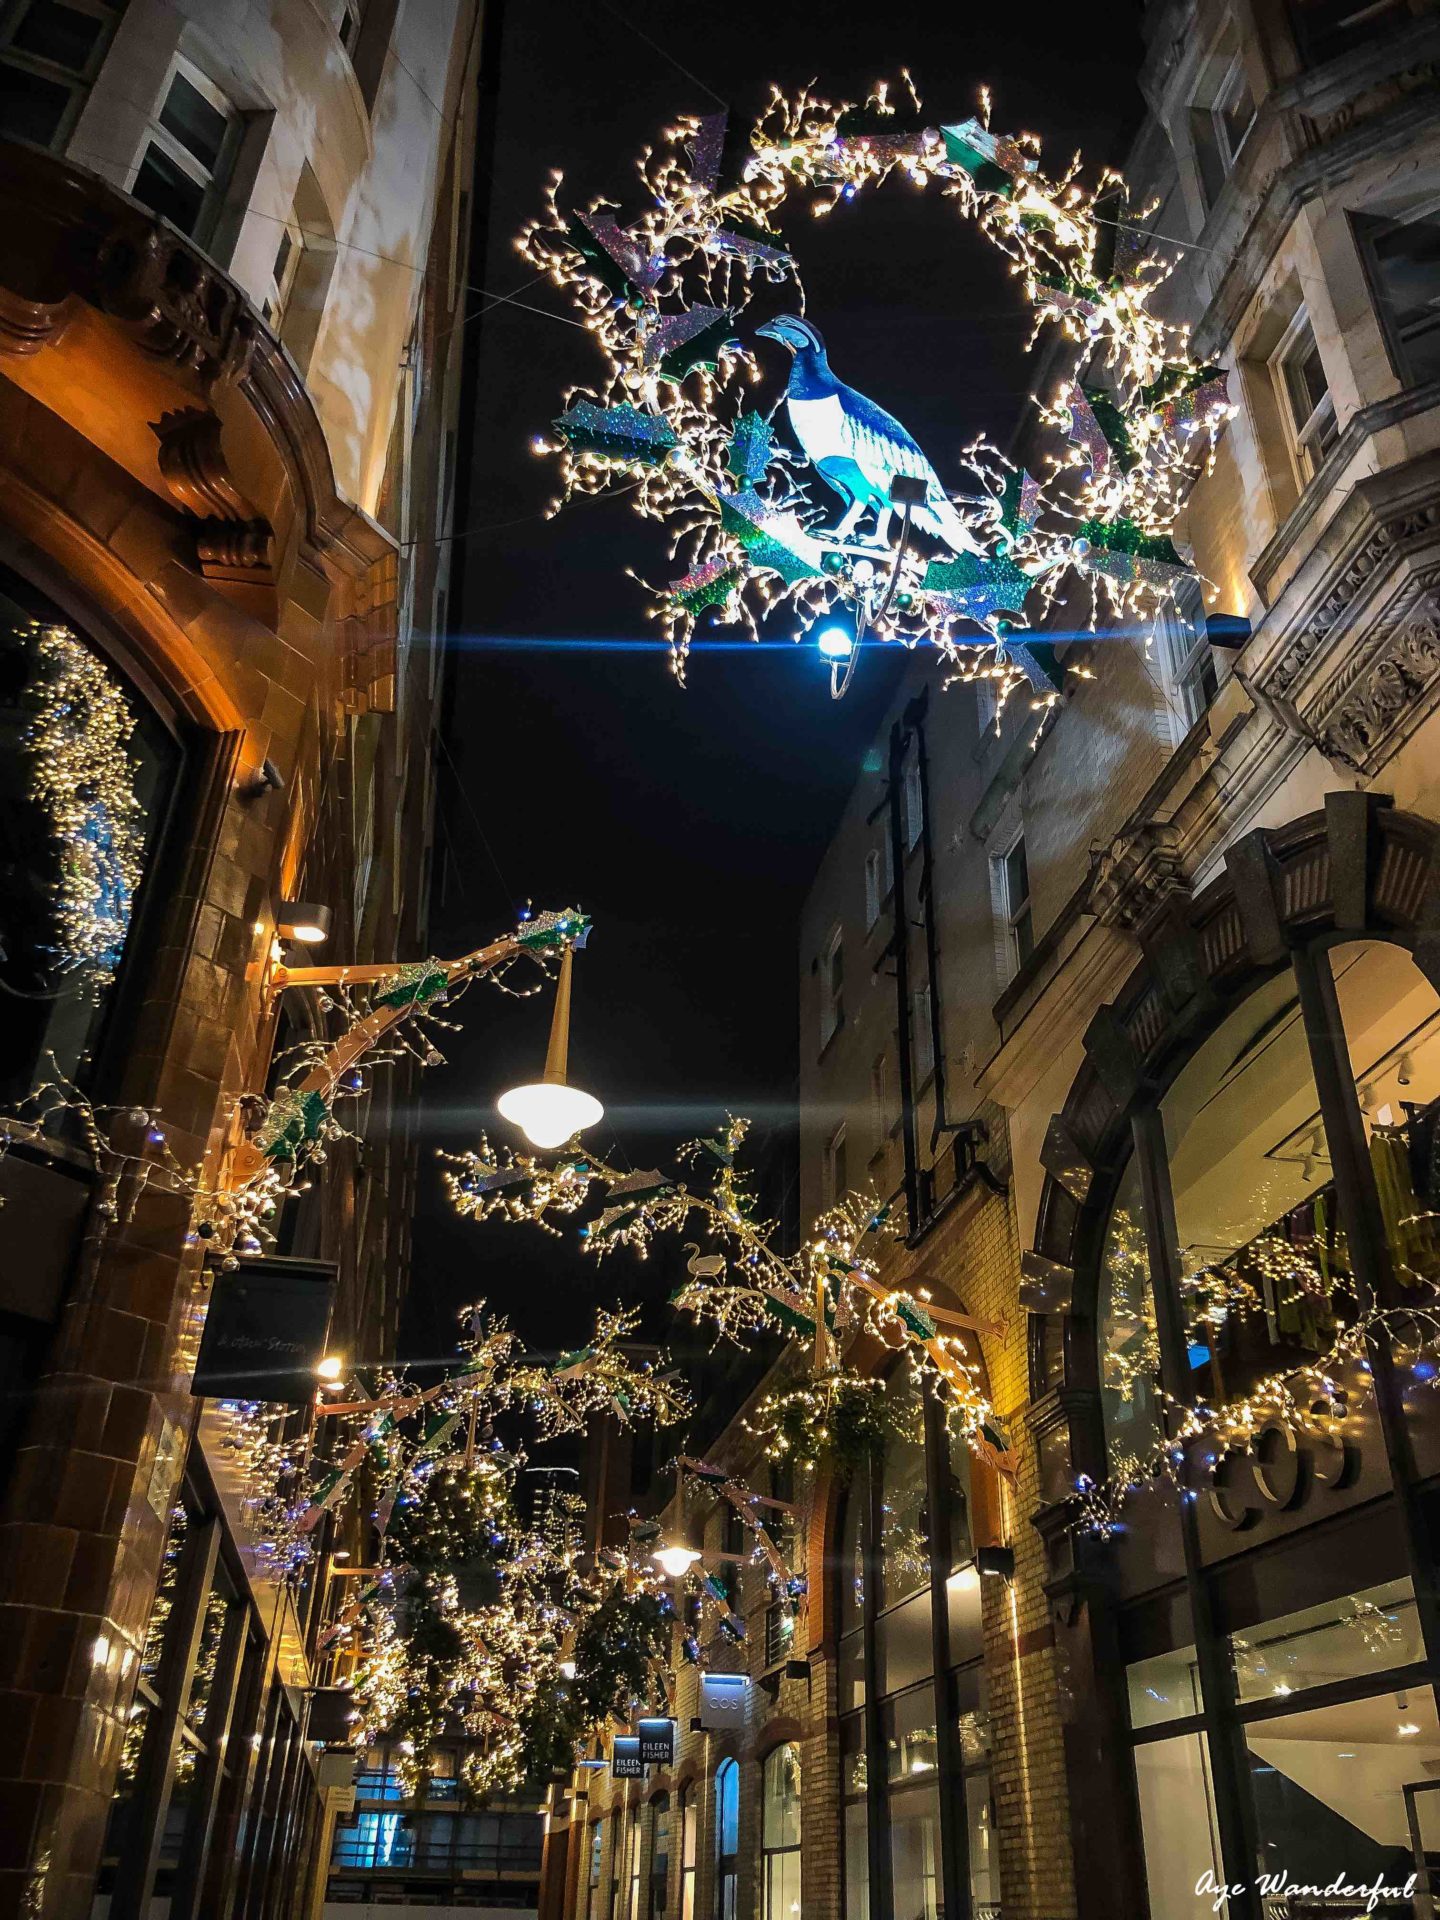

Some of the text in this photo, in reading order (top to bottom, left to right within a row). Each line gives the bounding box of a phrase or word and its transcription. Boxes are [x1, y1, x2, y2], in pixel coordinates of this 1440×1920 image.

[709, 1697, 738, 1710] COS
[642, 1742, 670, 1751] EILEEN
[642, 1751, 669, 1760] FISHER
[616, 1758, 641, 1767] EILEEN
[616, 1766, 641, 1774] FISHER
